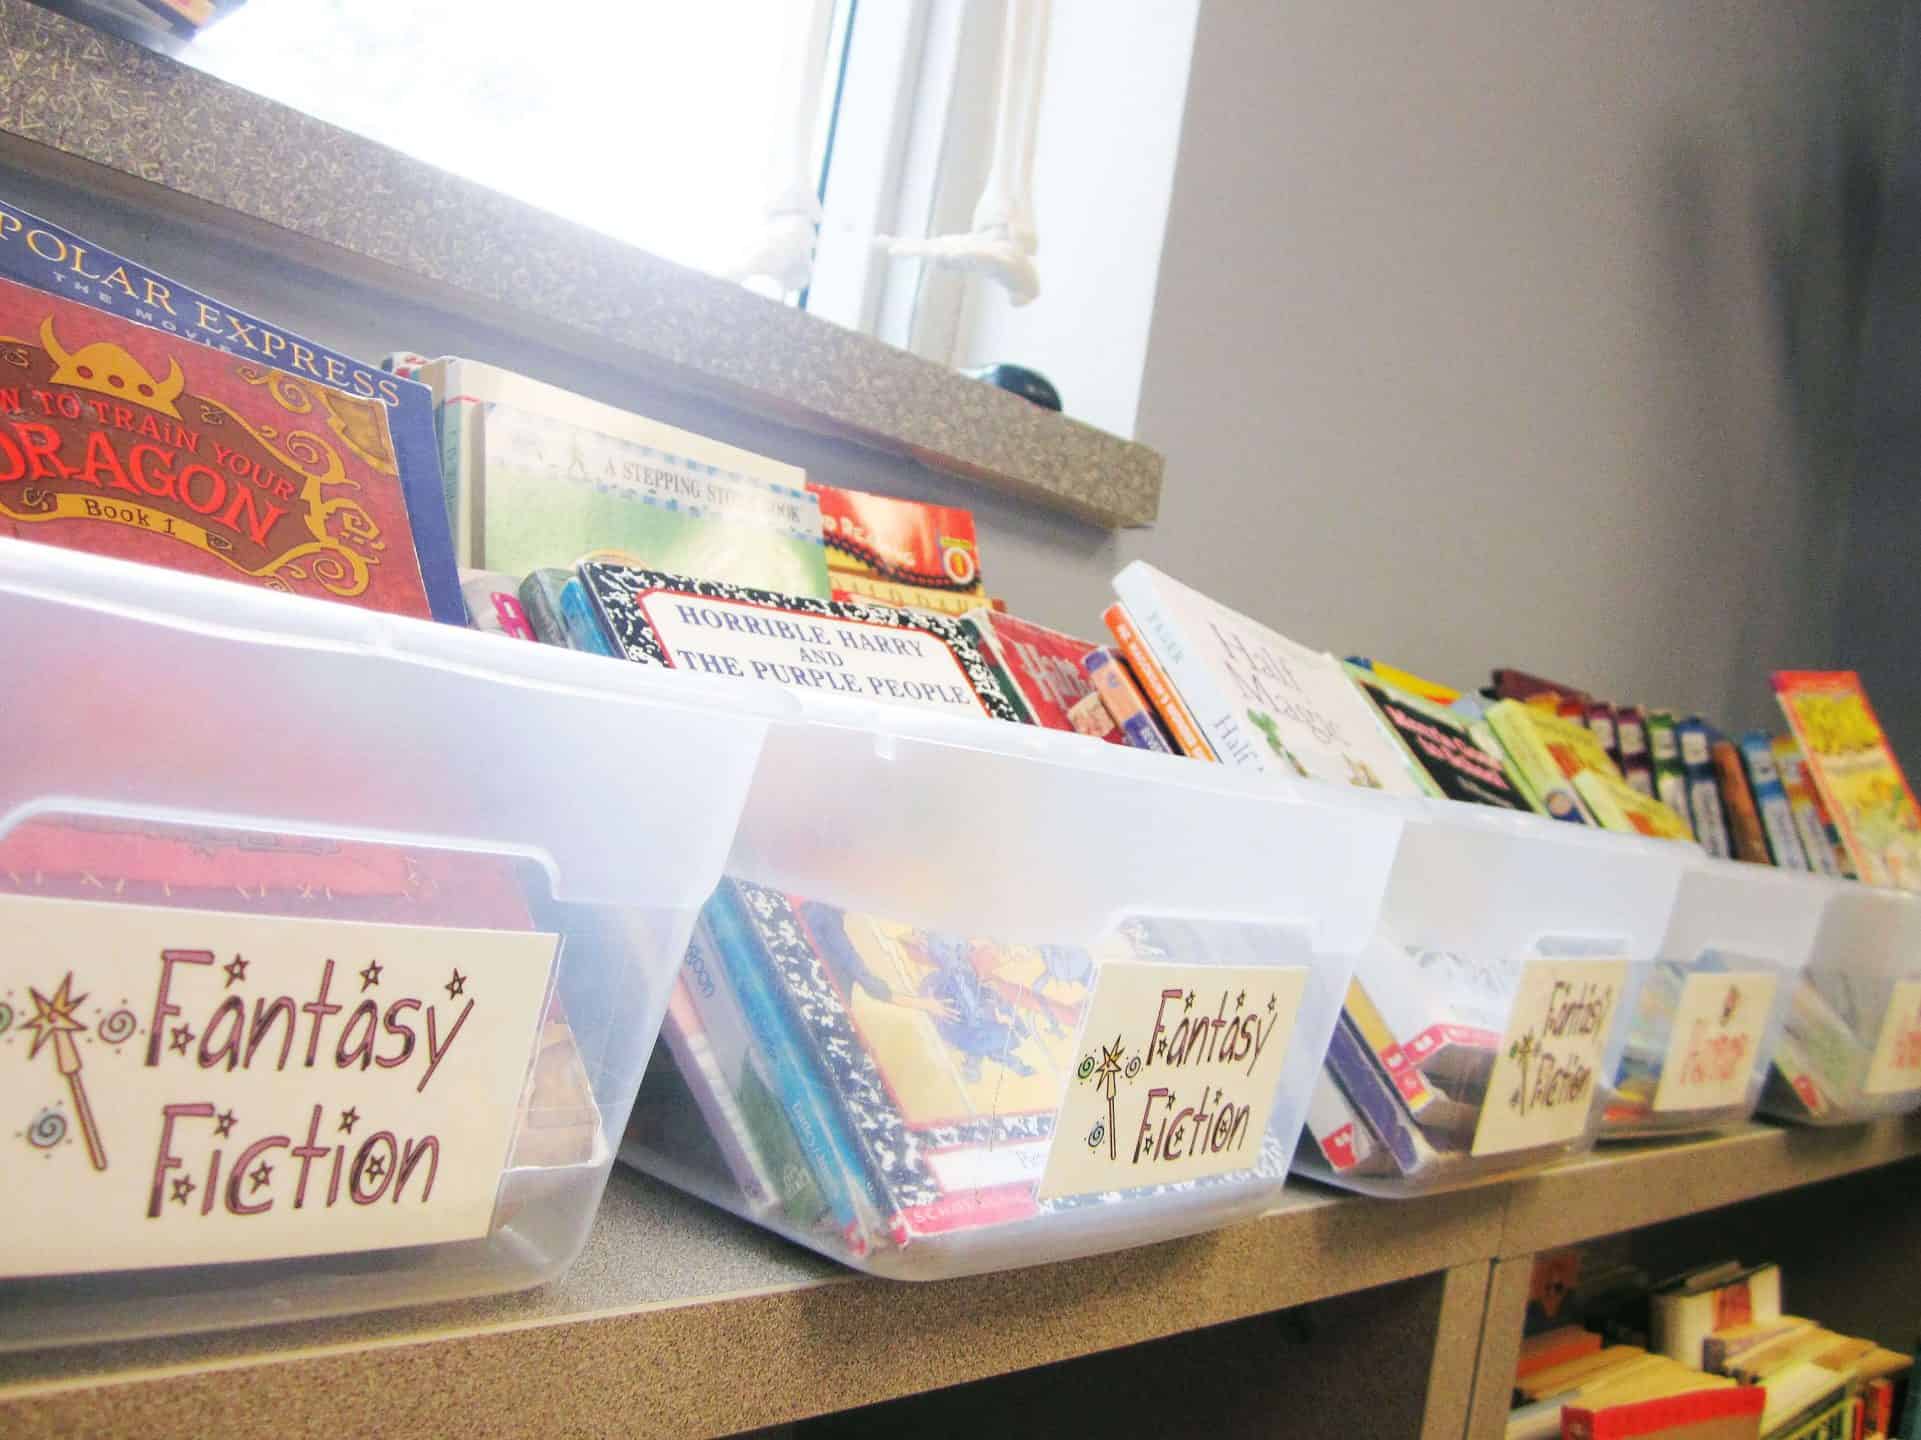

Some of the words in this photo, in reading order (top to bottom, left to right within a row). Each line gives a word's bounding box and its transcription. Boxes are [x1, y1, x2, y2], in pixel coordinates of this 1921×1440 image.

[0, 210, 177, 316] POLAR
[194, 300, 400, 408] EXPRESS
[52, 271, 112, 305] THE
[32, 389, 81, 419] TO
[213, 442, 297, 501] YOUR
[622, 462, 701, 499] STEPPING
[82, 497, 151, 528] Book
[163, 518, 176, 537] 1
[674, 604, 832, 646] HORRIBLE
[836, 629, 924, 658] HARRY
[799, 647, 845, 668] AND
[676, 649, 745, 678] THE
[749, 661, 863, 693] PURPLE
[867, 676, 971, 705] PEOPLE
[143, 948, 475, 1093] Fantasy
[1145, 988, 1278, 1077] Fantasy
[1132, 1087, 1251, 1164] Fiction
[146, 1103, 441, 1218] Fiction
